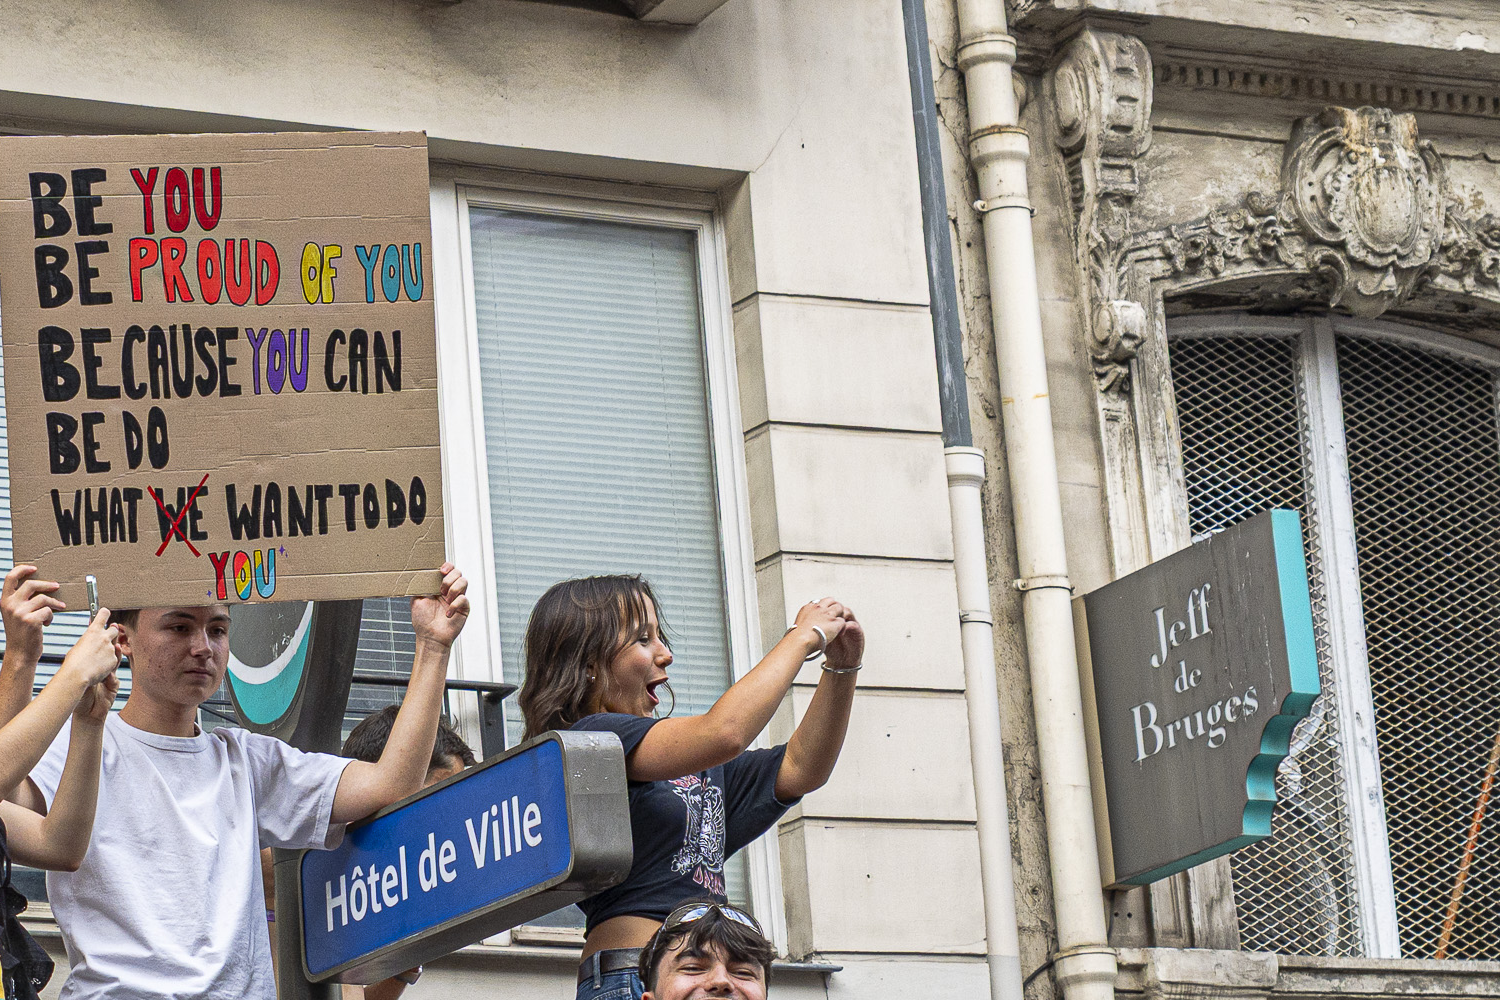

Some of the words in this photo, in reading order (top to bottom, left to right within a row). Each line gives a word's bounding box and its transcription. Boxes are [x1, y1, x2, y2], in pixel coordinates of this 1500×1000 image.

[29, 168, 113, 239] BE
[130, 166, 222, 234] YOU
[34, 240, 113, 308] BE
[129, 237, 281, 306] PROUD
[300, 241, 343, 304] OF
[355, 243, 424, 303] YOU
[38, 324, 242, 402] BECAUSE
[245, 328, 310, 394] YOU
[324, 328, 402, 394] CAN
[45, 411, 111, 474] BE
[123, 406, 170, 470] DO
[50, 486, 143, 546] WHAT
[154, 485, 209, 542] WE
[207, 547, 277, 601] YOU
[1151, 583, 1212, 668] Jeff
[1174, 660, 1201, 694] de
[1130, 685, 1260, 763] Bruges
[325, 845, 408, 932] Hôtel
[418, 832, 457, 893] de
[465, 796, 543, 870] Ville
